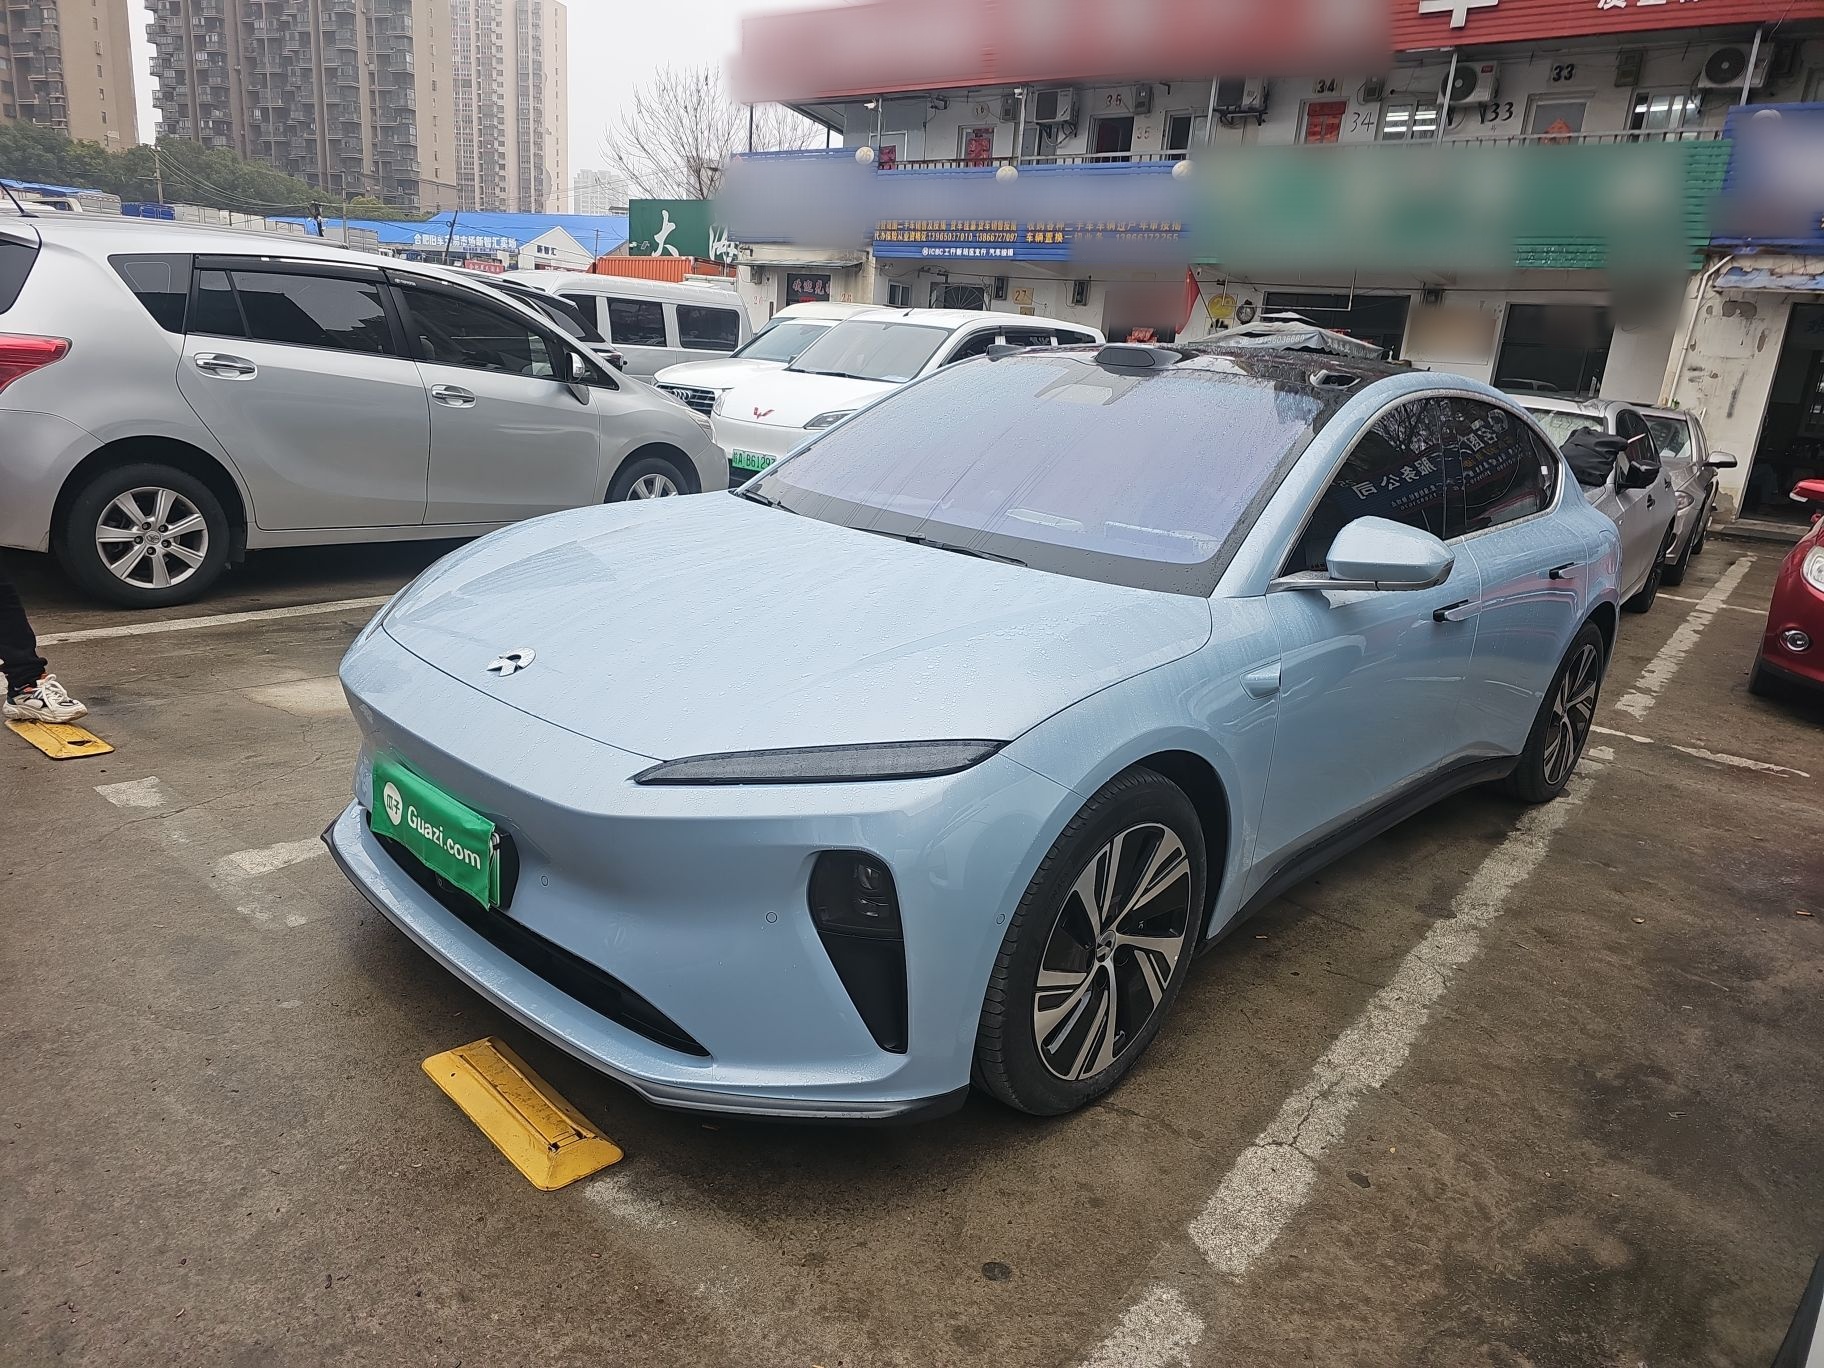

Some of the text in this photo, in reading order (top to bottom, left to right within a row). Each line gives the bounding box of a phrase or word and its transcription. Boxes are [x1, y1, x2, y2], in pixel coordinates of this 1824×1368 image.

[1552, 63, 1575, 82] 33
[1317, 78, 1336, 94] 34
[1350, 111, 1374, 133] 34
[1487, 102, 1514, 122] 33
[407, 805, 481, 870] Guazi.com
